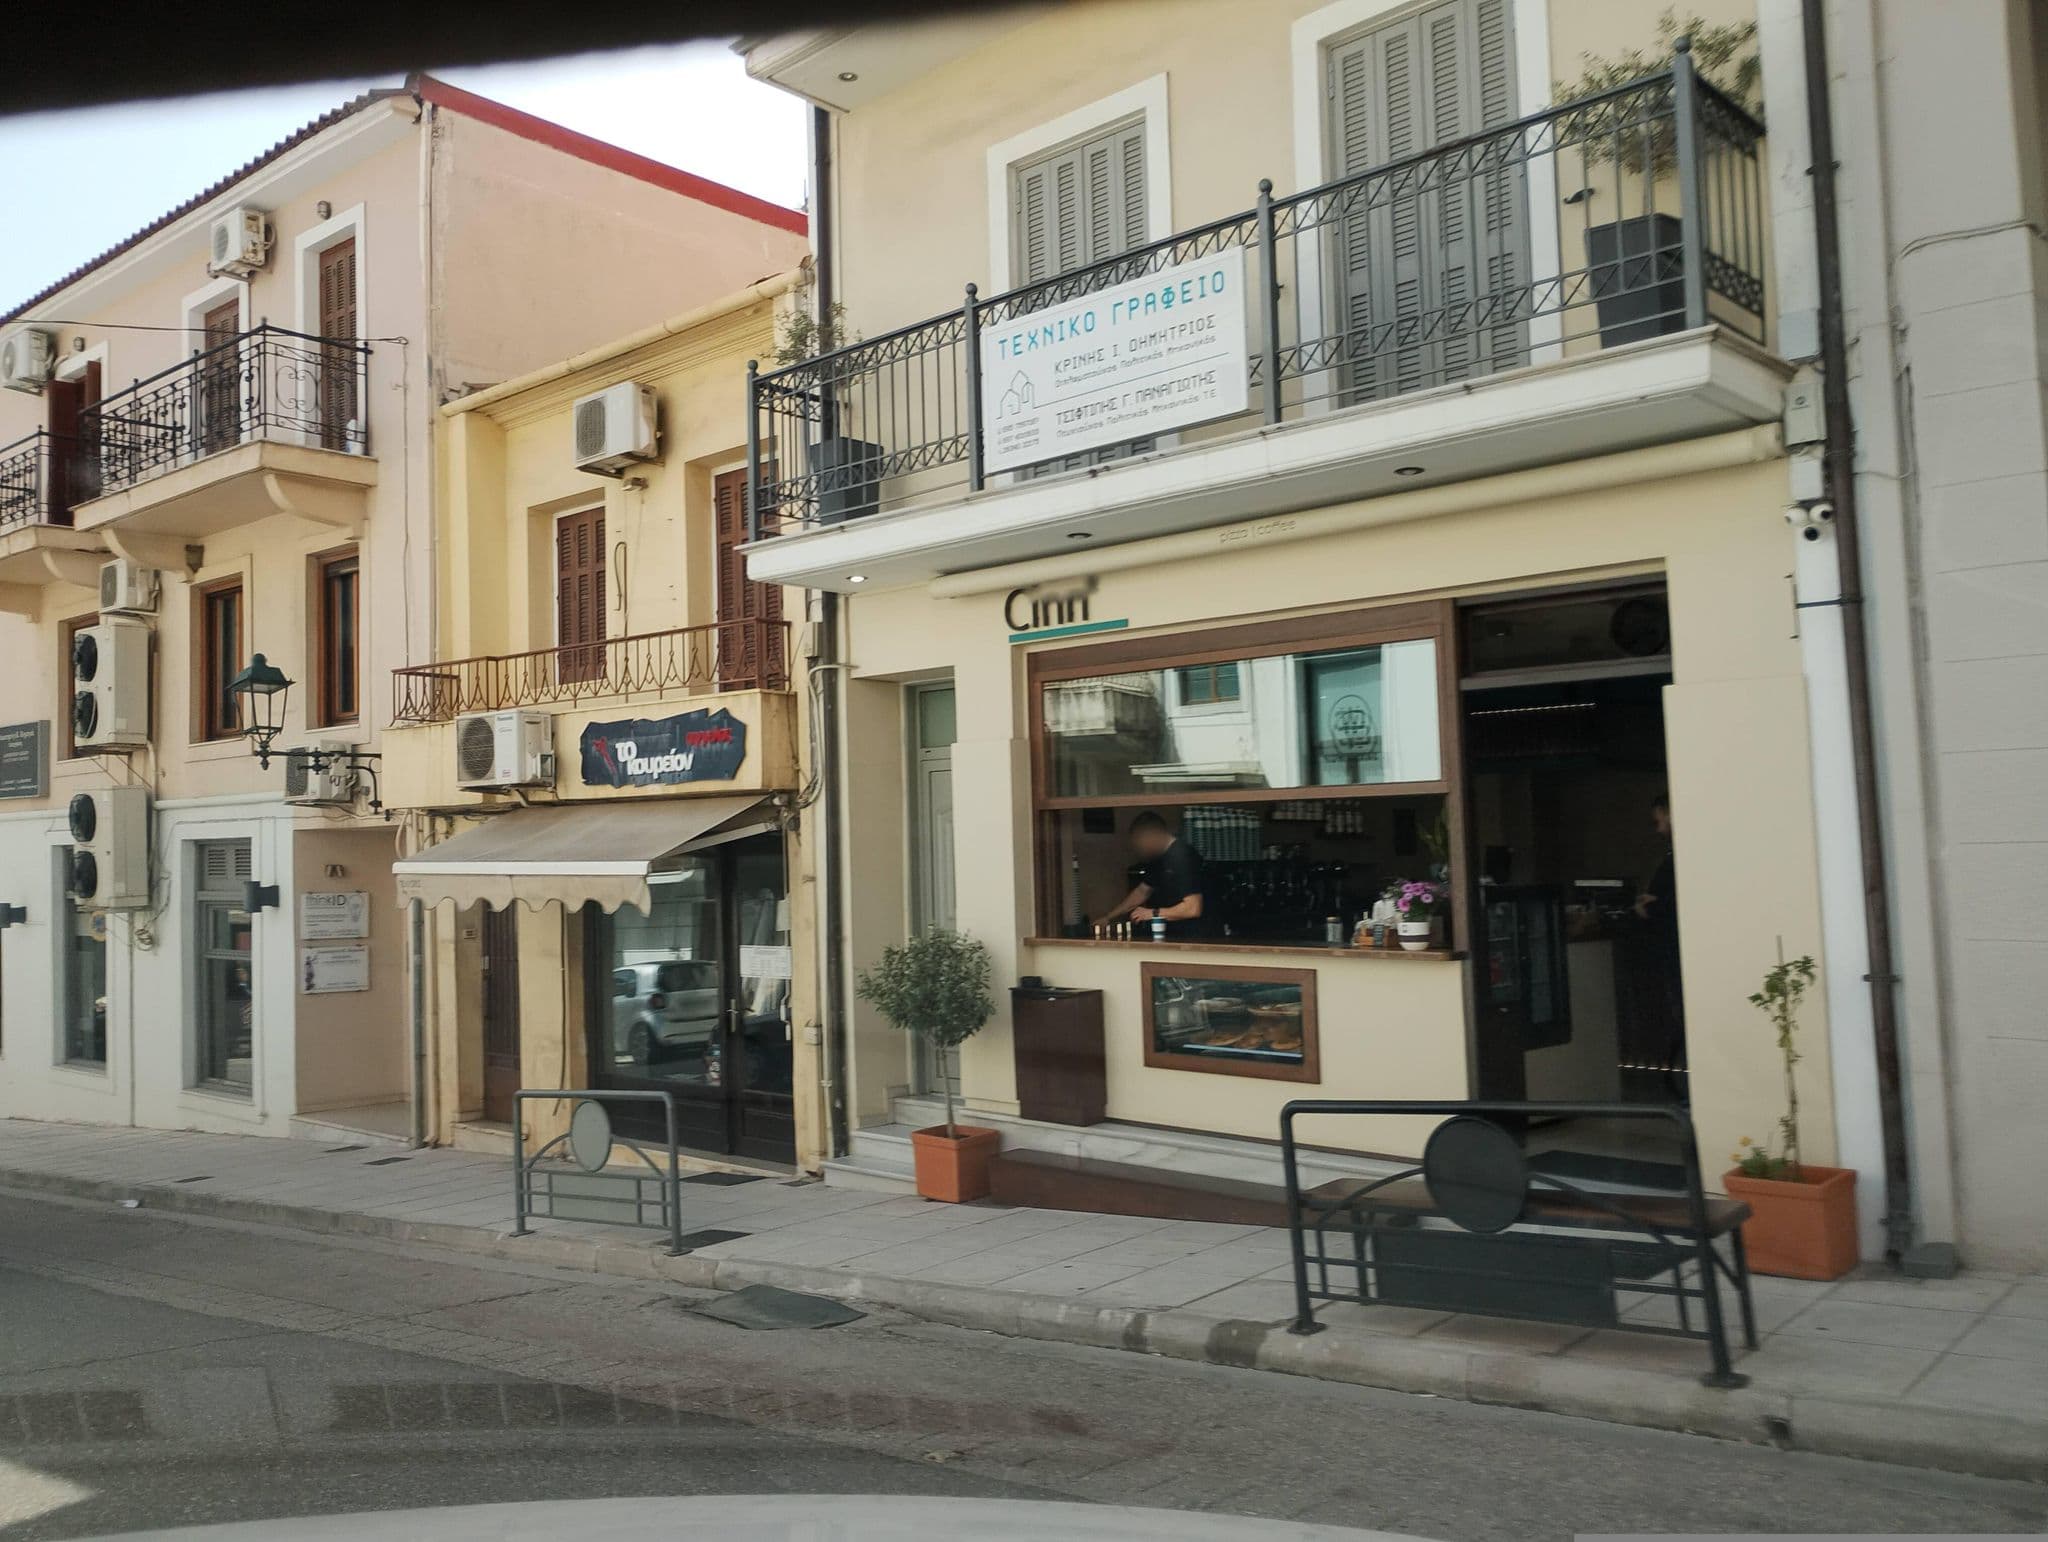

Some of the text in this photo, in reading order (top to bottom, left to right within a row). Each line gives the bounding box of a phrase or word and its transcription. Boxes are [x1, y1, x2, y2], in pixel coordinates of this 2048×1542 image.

[998, 270, 1225, 360] ΤΕΧΝΙΚΟ ΓΡΑΦΕΙΟ
[1054, 347, 1105, 373] ΚΡΙΝΗΣ
[1129, 314, 1217, 352] ΔΗΜΗΤΡΙΟΣ
[1135, 369, 1217, 404] ΠΑΝΑΓΙΩΤΗΣ
